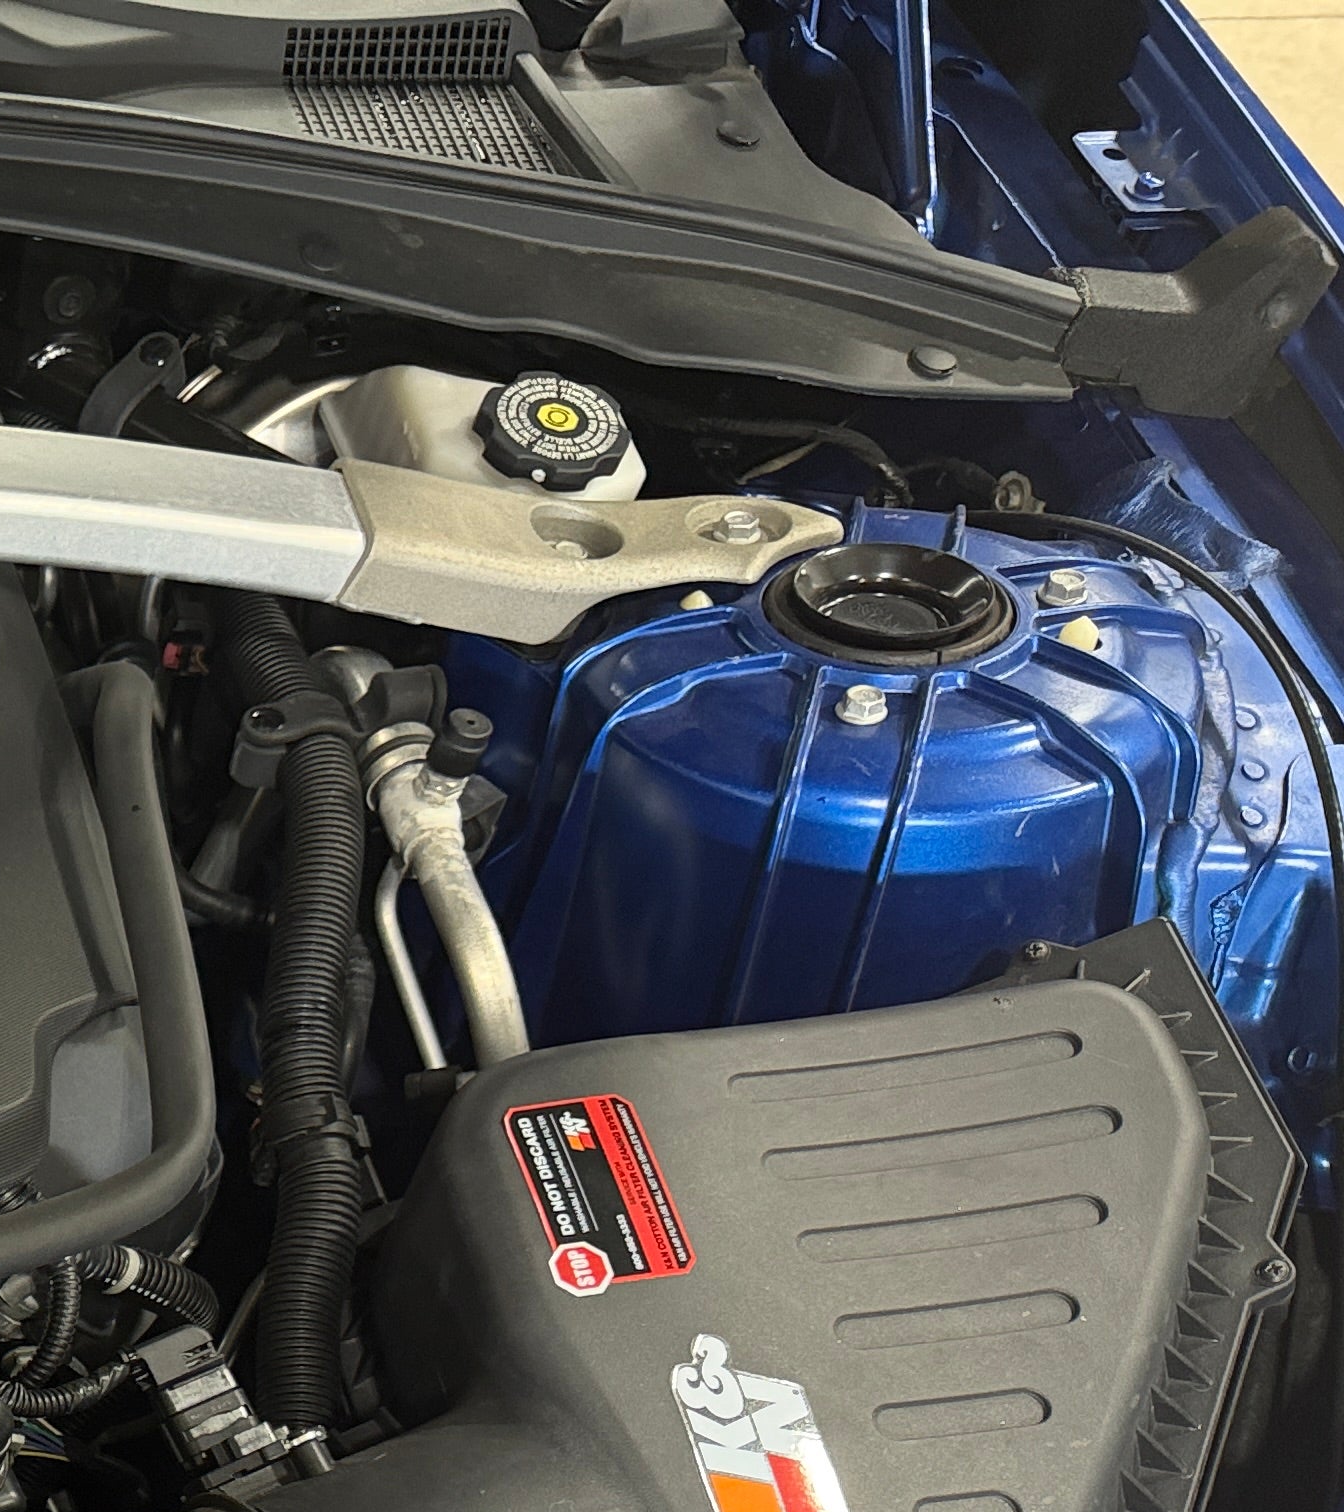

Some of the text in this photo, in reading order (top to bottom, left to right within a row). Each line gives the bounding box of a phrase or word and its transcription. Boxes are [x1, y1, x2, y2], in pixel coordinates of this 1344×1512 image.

[536, 1115, 551, 1138] FILTER
[546, 1137, 557, 1150] AIR
[517, 1117, 575, 1236] DO NOT DISCARD
[551, 1152, 572, 1187] REUSABLE
[598, 1099, 673, 1269] K&N COTTON AIR FILTER CLEANING SYSTEM
[614, 1161, 636, 1205] SERVICE WITH
[567, 1192, 590, 1233] WASHABLE
[658, 1204, 669, 1217] USE
[663, 1216, 677, 1236] FILTER
[565, 1249, 597, 1287] STOP
